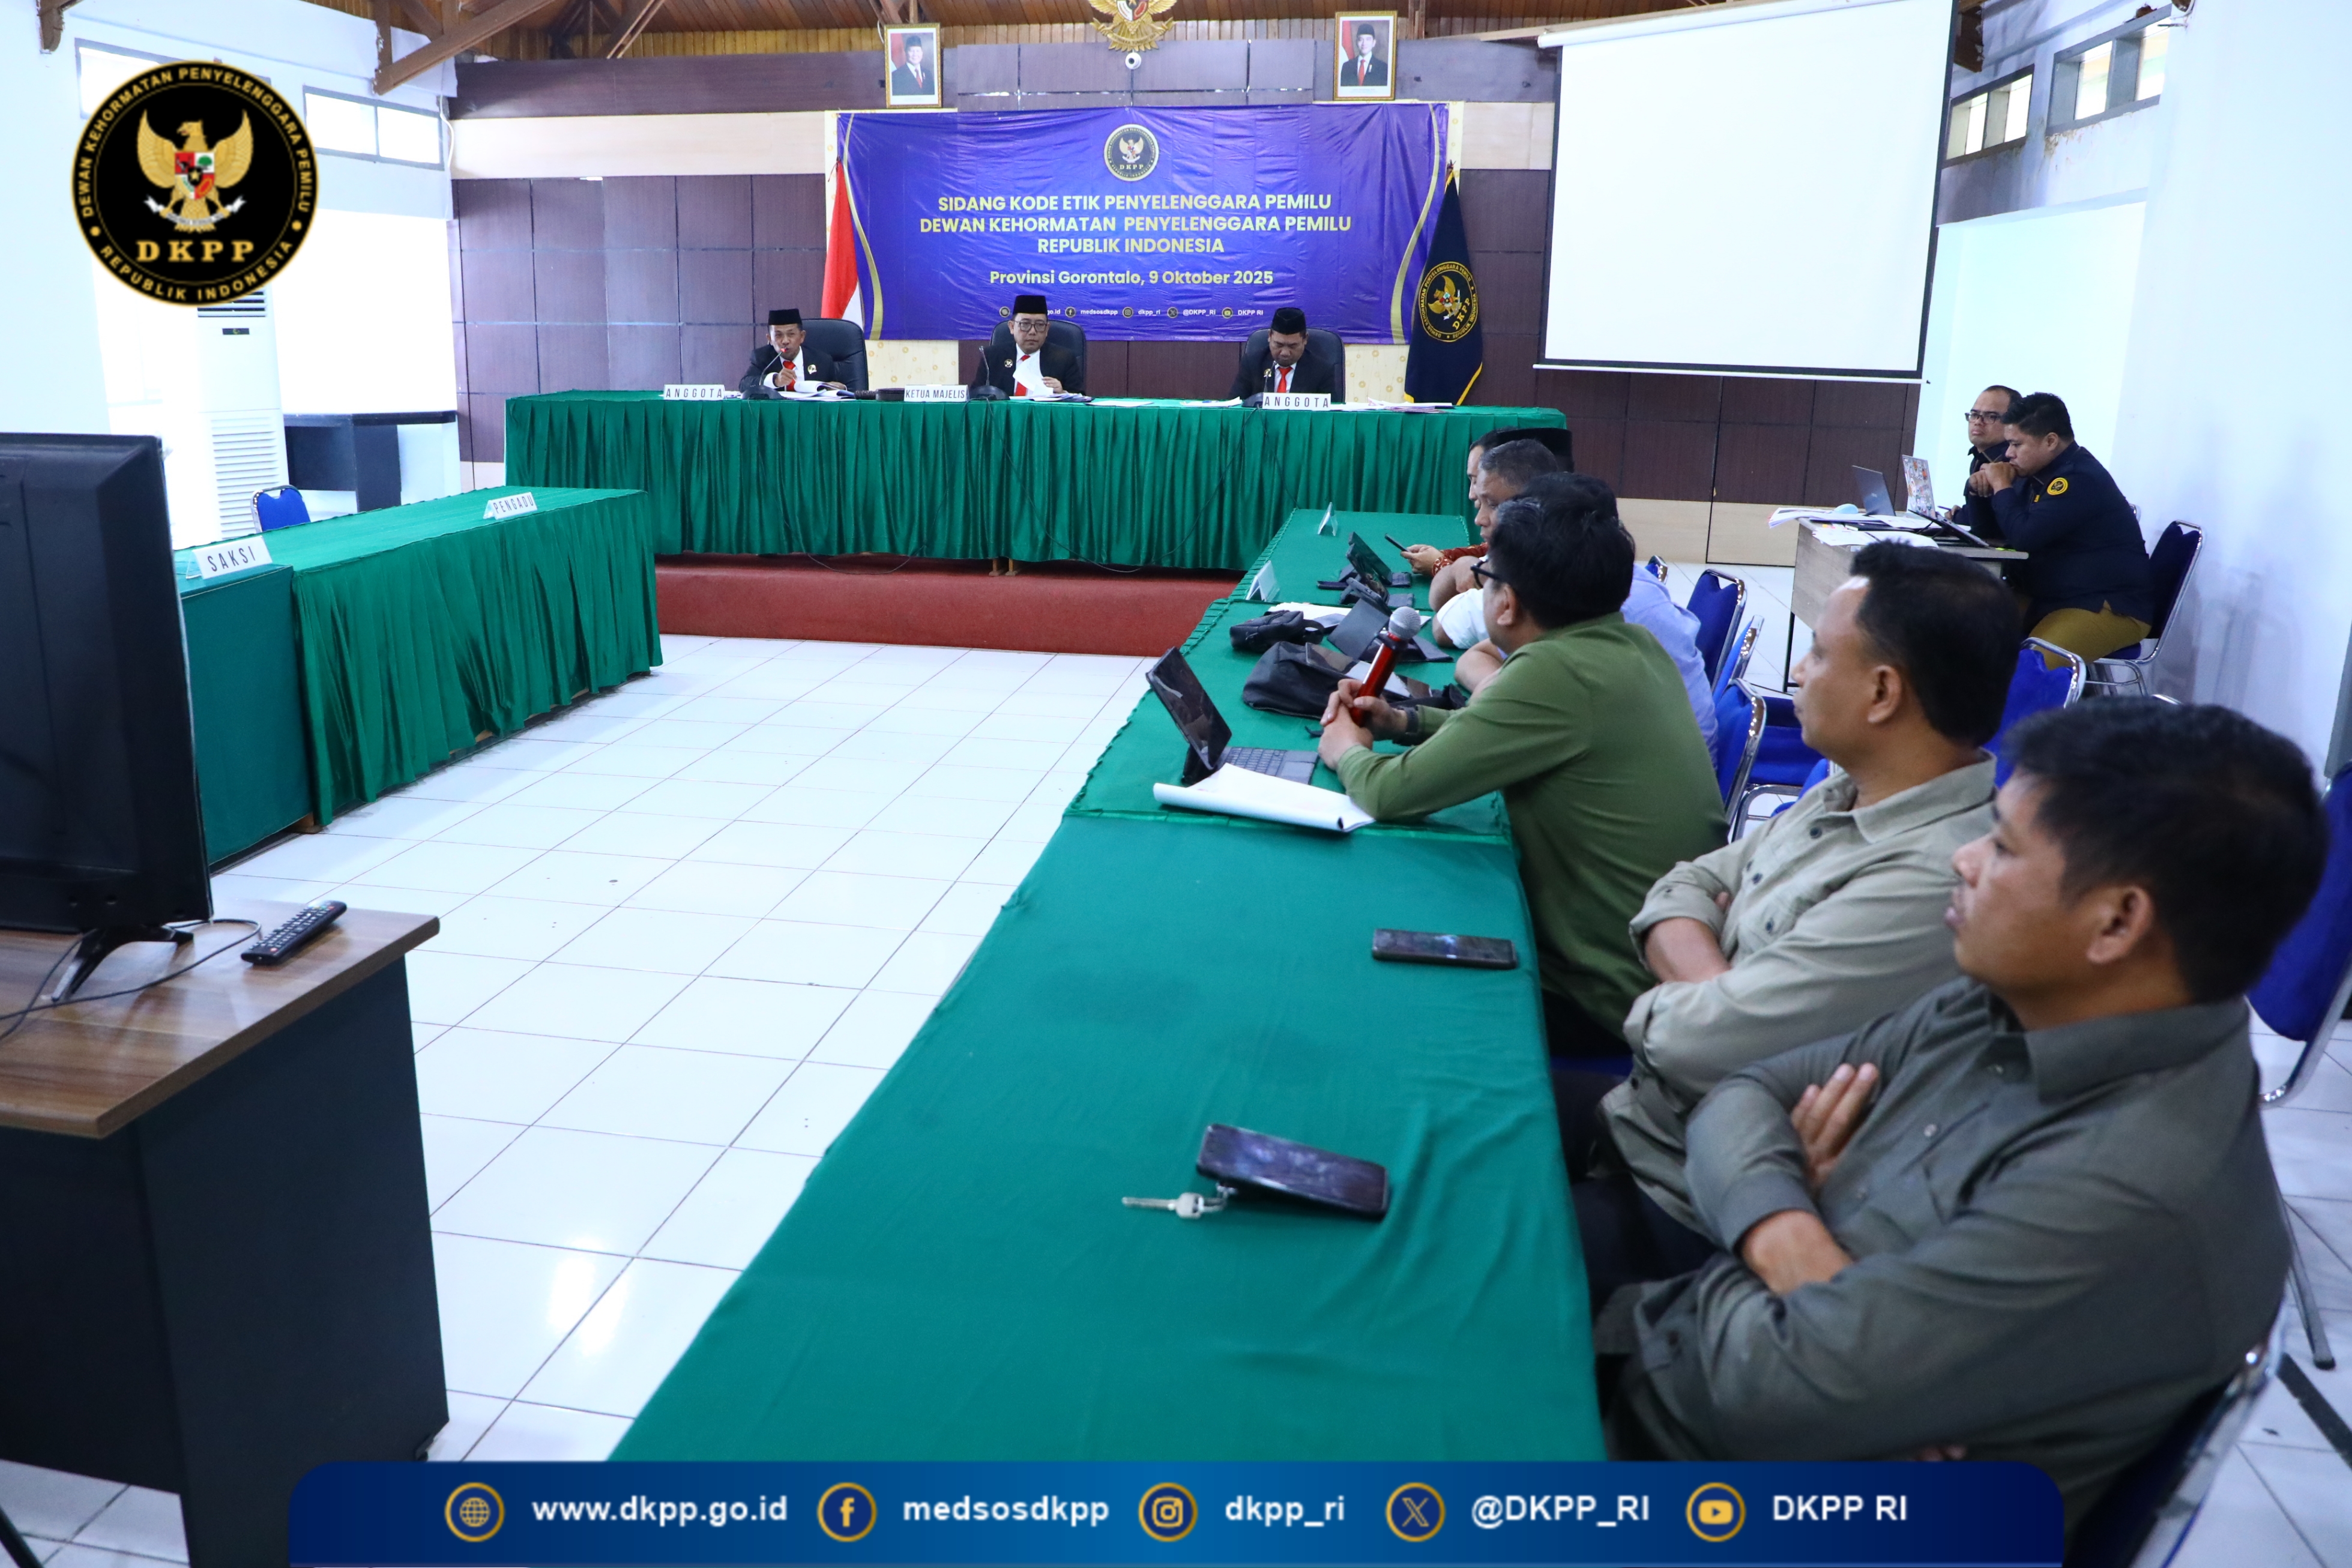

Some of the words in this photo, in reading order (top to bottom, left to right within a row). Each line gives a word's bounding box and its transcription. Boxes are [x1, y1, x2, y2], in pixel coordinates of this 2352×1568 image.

[938, 196, 1006, 211] SIDANG
[1010, 196, 1058, 210] KODE
[1063, 196, 1100, 210] ETIK
[1105, 194, 1260, 210] PENYELENGGARA
[1265, 194, 1331, 209] PEMILU
[920, 218, 985, 232] DEWAN
[989, 217, 1115, 231] KEHORMATAN
[1124, 217, 1280, 231] PENYELENGGARA
[1285, 217, 1351, 231] PEMILU
[1038, 238, 1120, 252] REPUBLIK
[1125, 238, 1224, 252] INDONESIA
[991, 270, 1055, 284] Provinsi
[1058, 270, 1145, 286] Gorontalo,
[1149, 271, 1159, 283] 9
[1162, 270, 1230, 284] Oktober
[1233, 271, 1273, 284] 2025
[1453, 298, 1470, 330] DKPP
[666, 388, 722, 398] ANGGOTA
[905, 390, 930, 398] KETUA
[933, 390, 965, 399] MAJELIS
[1264, 396, 1328, 408] ANGGOTA
[493, 495, 534, 514] PENGADU
[207, 546, 256, 572] SAKSI
